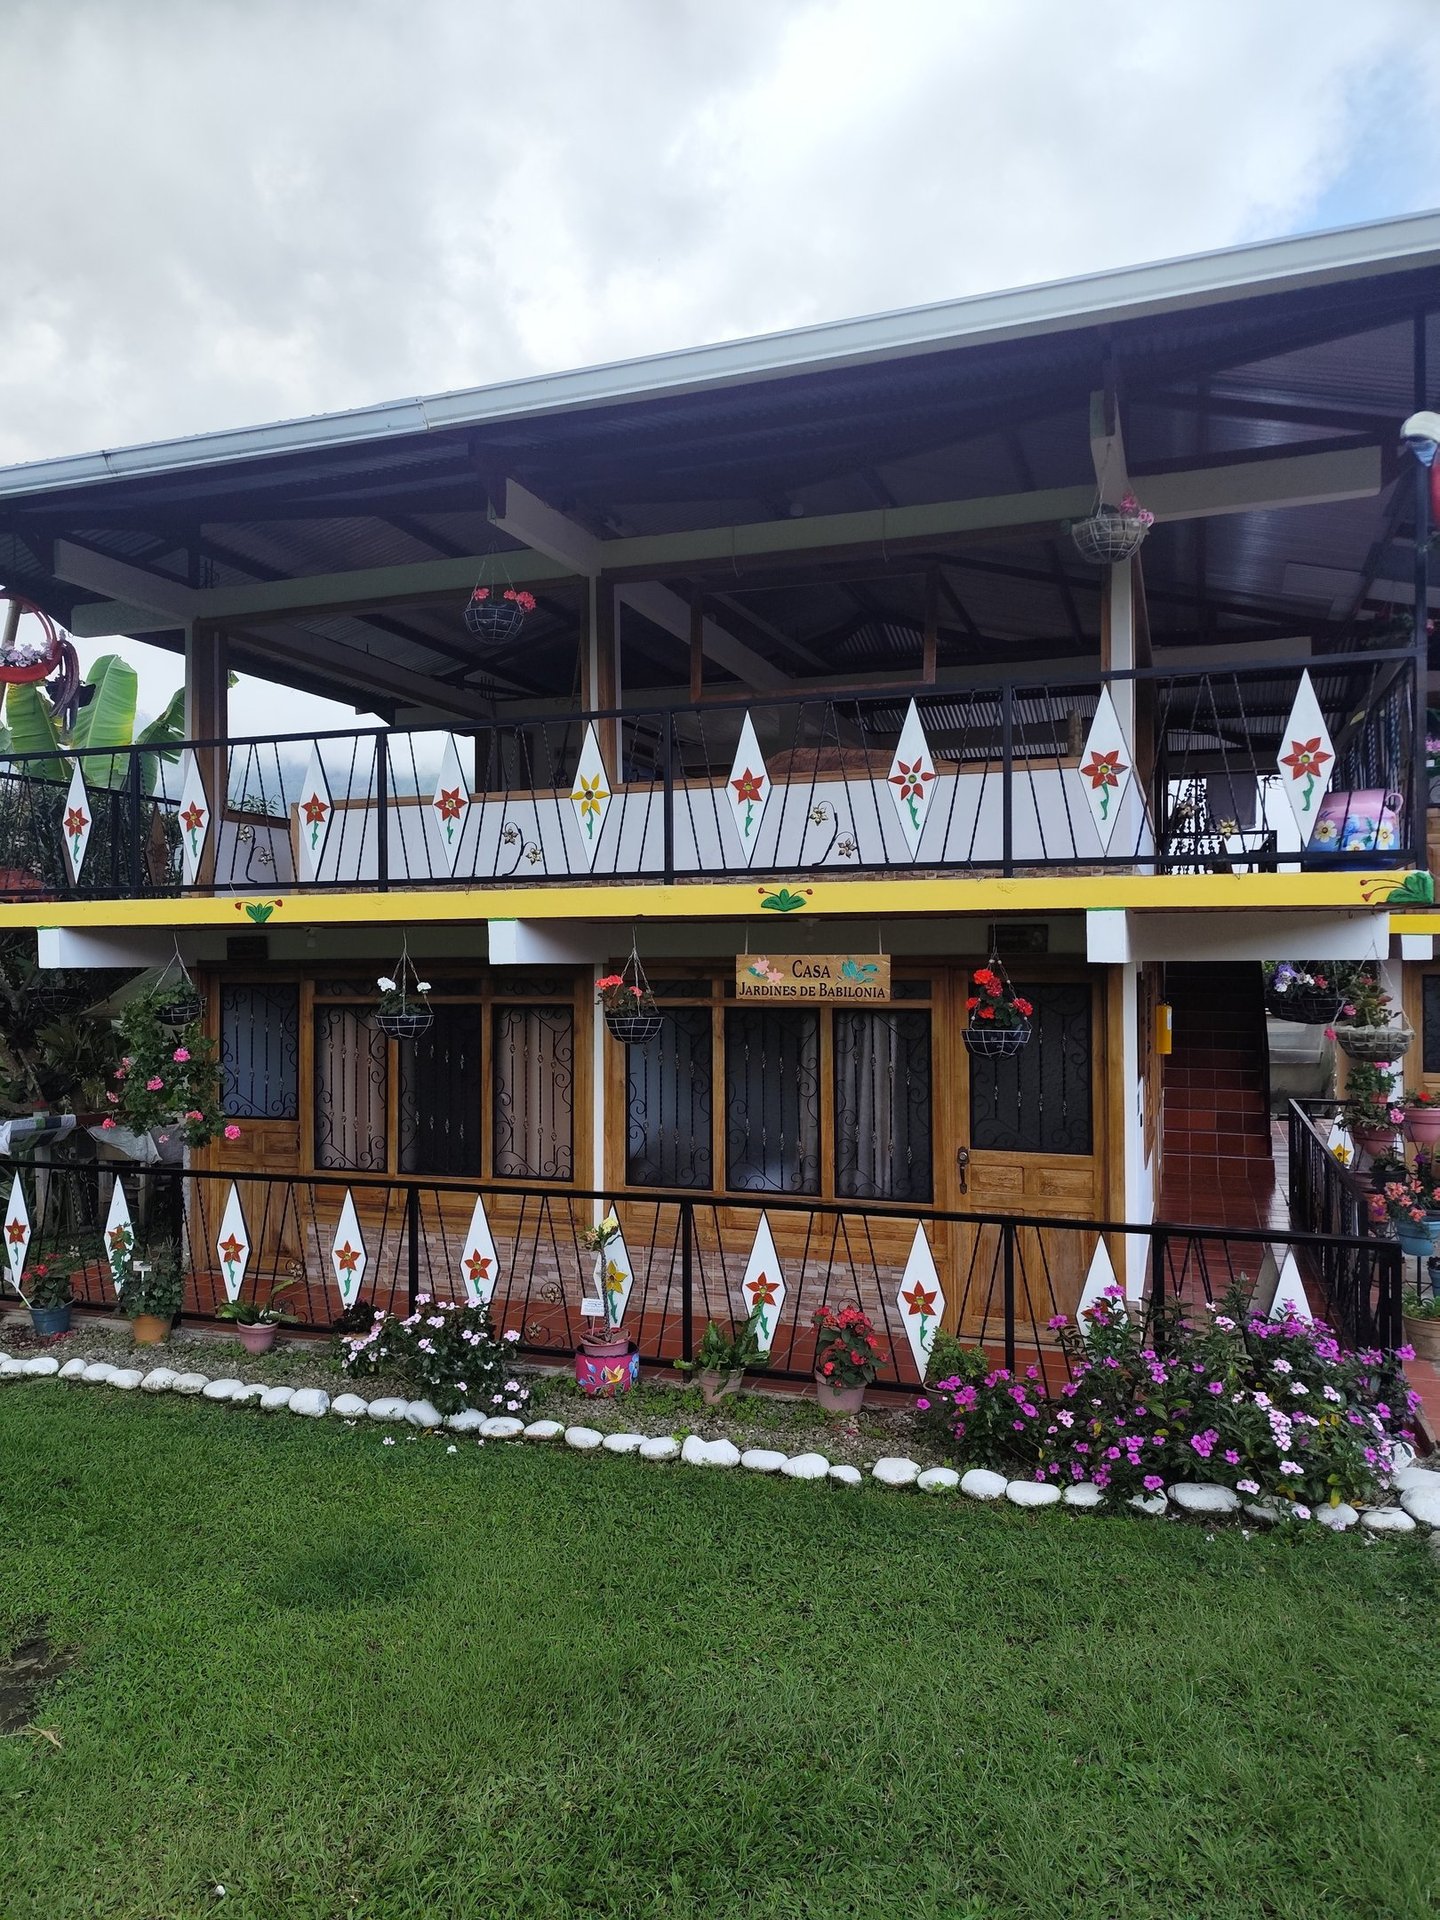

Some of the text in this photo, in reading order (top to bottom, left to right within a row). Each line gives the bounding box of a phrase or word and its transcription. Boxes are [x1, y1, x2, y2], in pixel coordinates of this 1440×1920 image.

[792, 959, 831, 979] CASA
[739, 981, 886, 999] JARDINES DE BABILONIA
